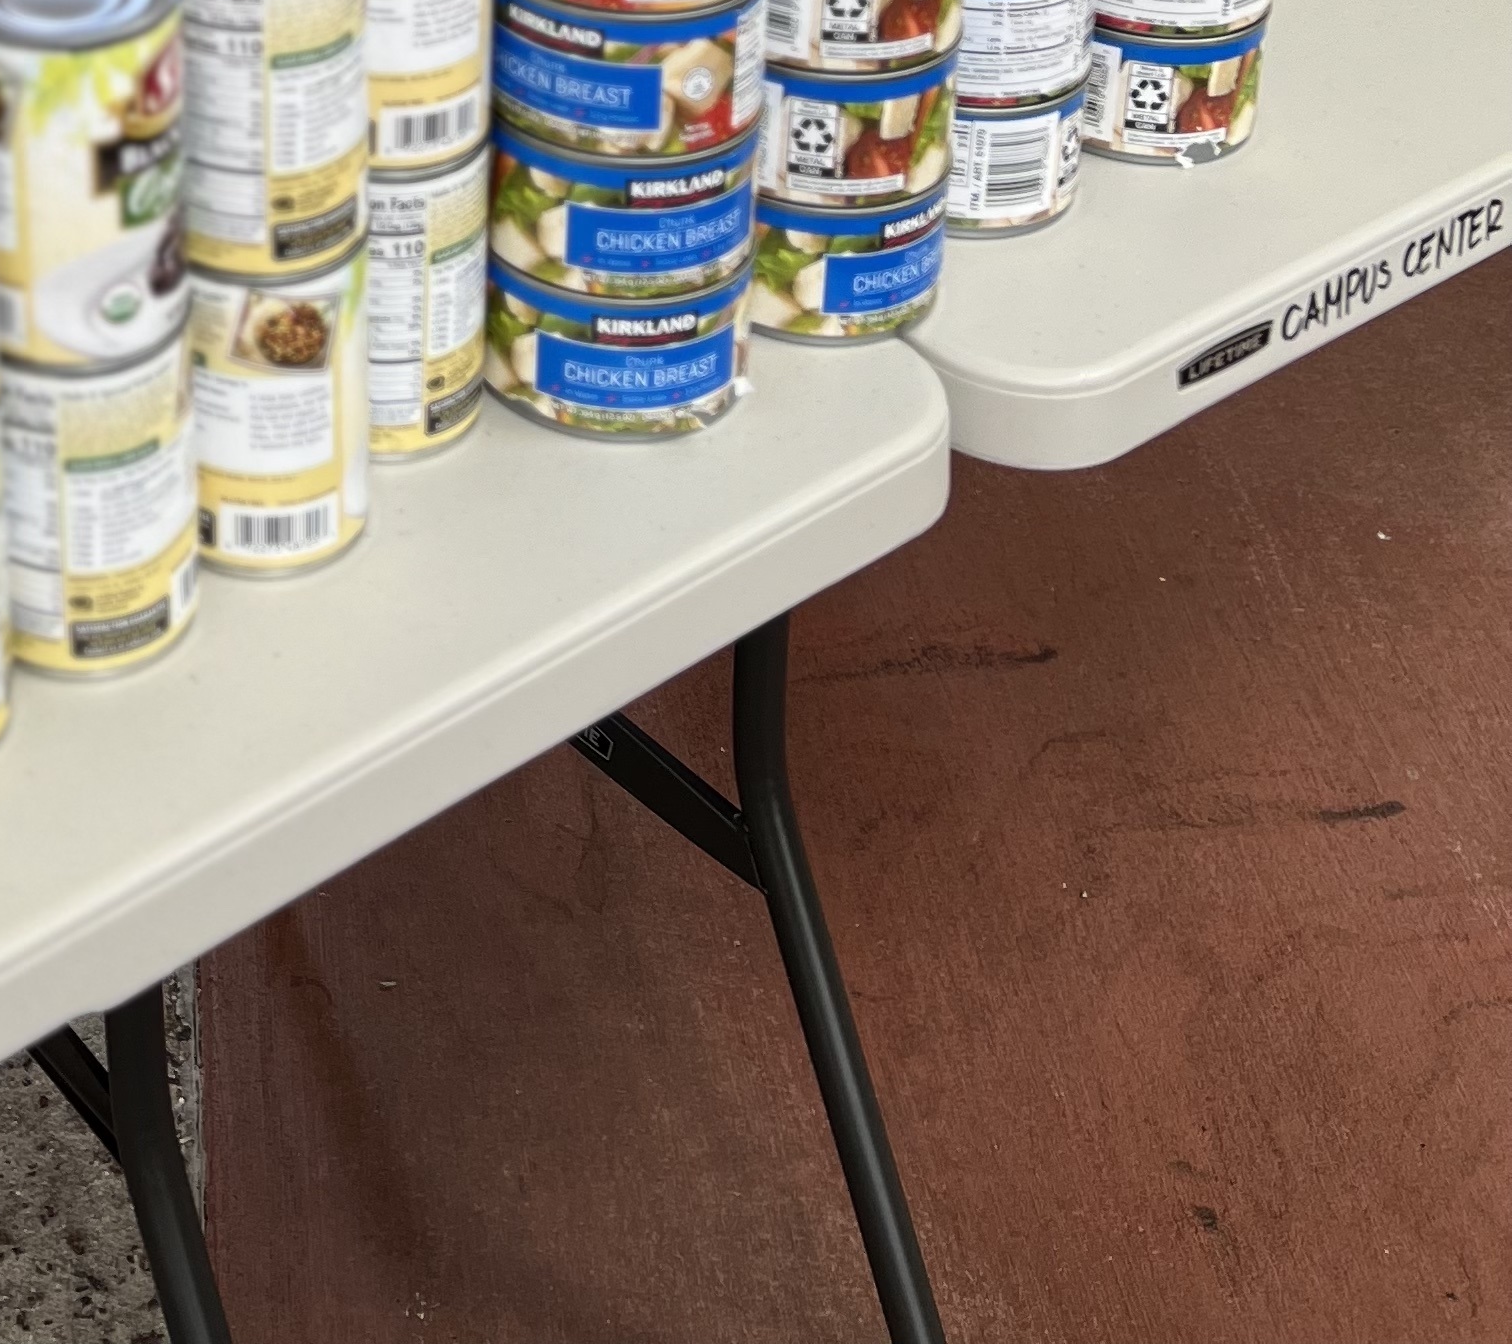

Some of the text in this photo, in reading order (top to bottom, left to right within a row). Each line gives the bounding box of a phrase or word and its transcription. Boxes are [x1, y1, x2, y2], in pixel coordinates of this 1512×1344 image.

[508, 2, 603, 48] KIRKLAND
[554, 76, 632, 106] BREAST
[630, 169, 725, 199] KIRKLAND
[596, 208, 742, 253] CHICKEN BREAST
[392, 239, 424, 257] 110
[852, 263, 921, 294] CHICKEN
[1280, 198, 1504, 342] CAMPUS CENTER
[595, 314, 698, 337] KIRKLAND
[564, 353, 719, 388] CHICKEN BREAST
